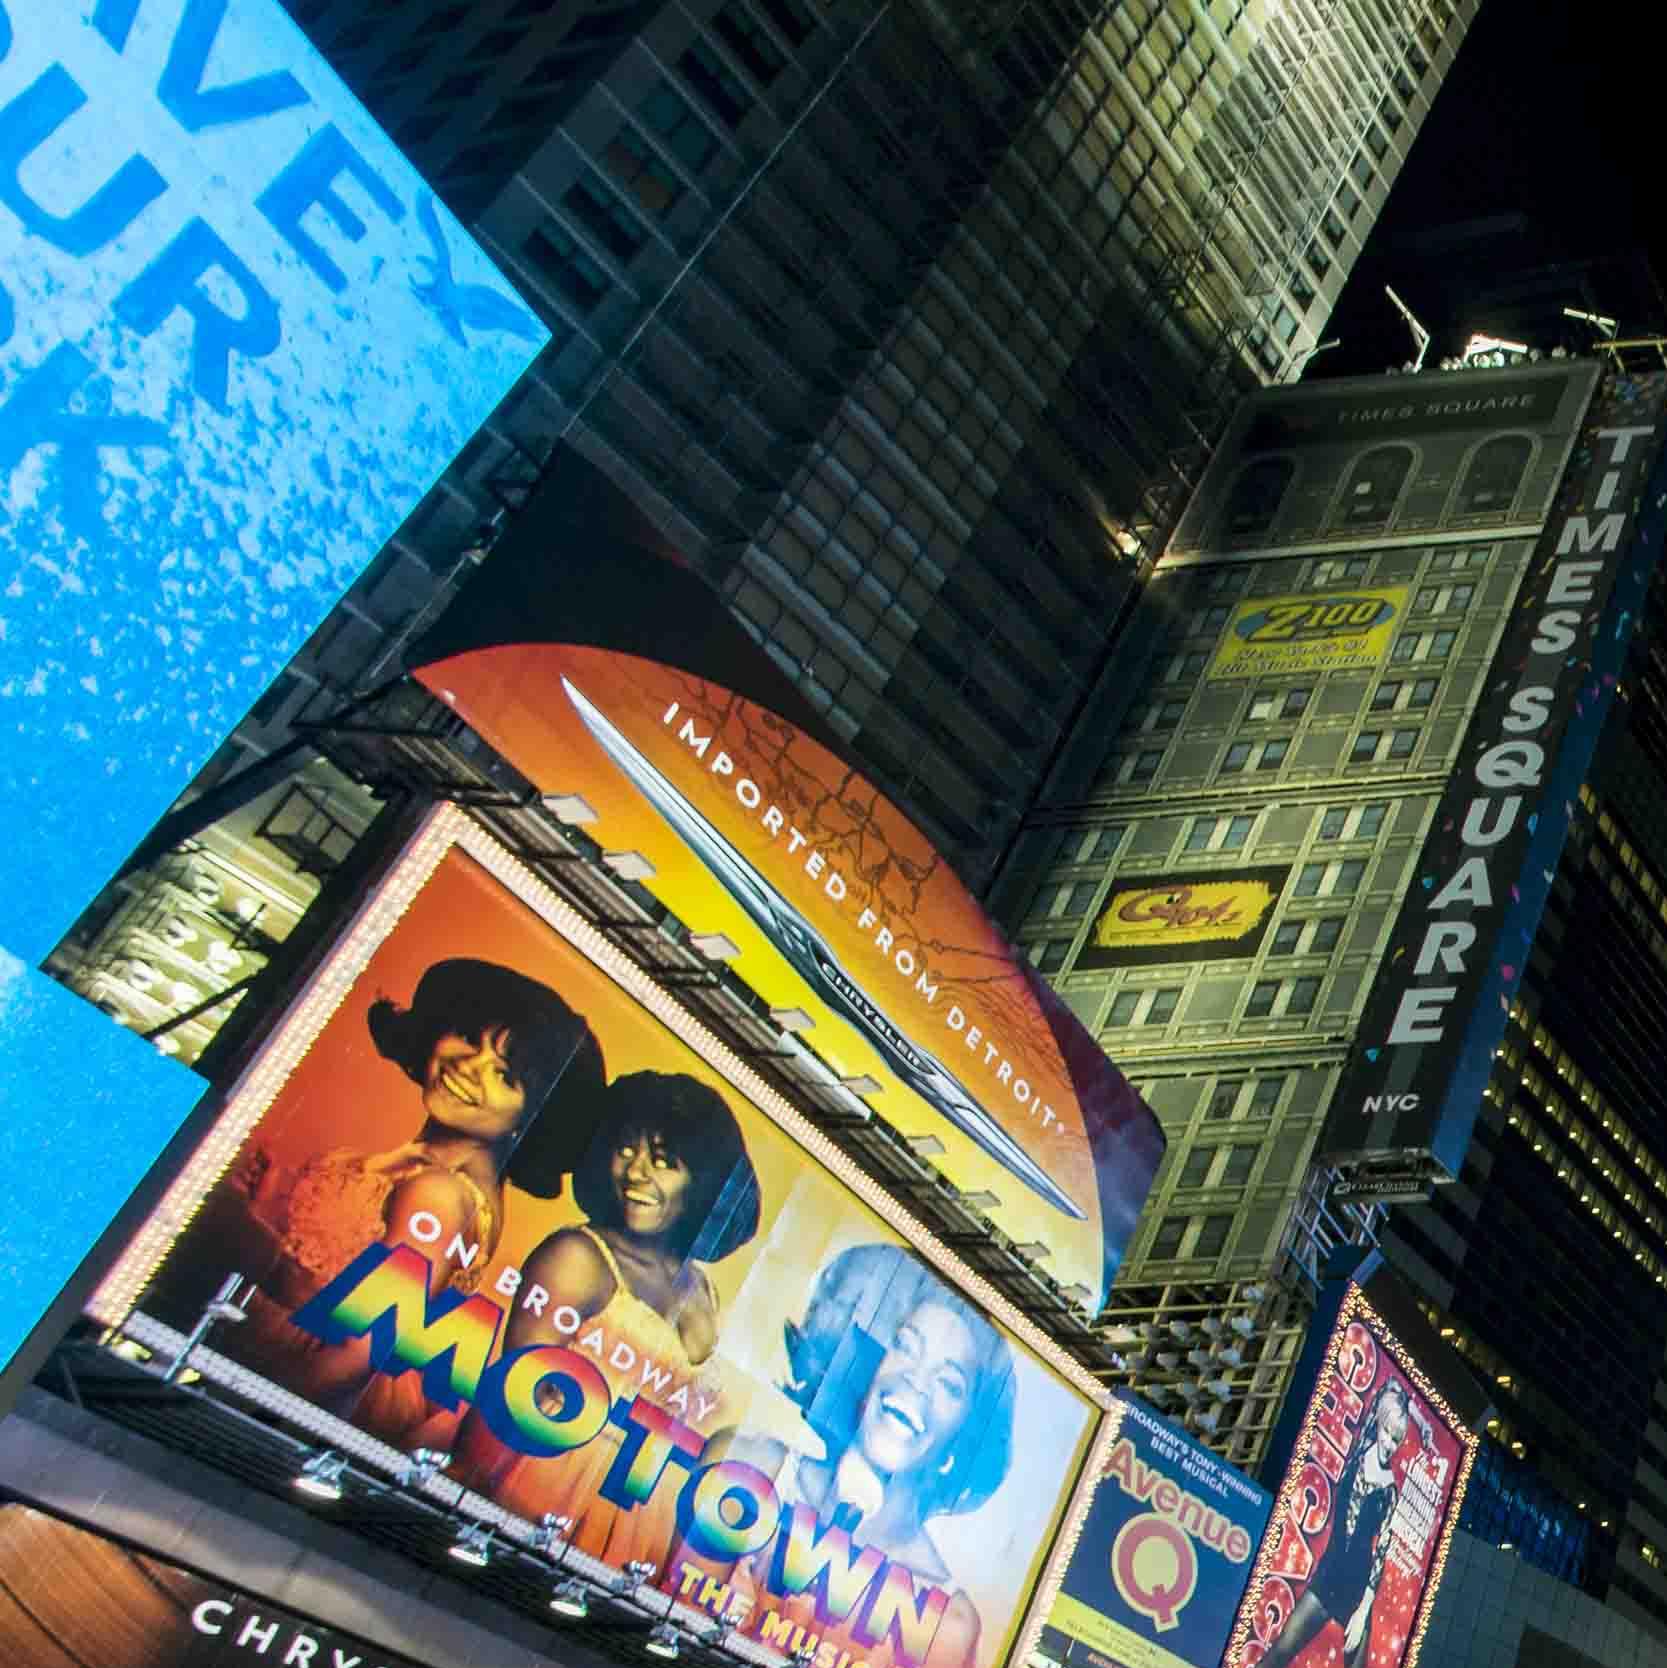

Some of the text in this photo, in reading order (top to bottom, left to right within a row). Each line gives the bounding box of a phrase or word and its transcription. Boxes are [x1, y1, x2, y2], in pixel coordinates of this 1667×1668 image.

[1248, 598, 1386, 643] Z100
[1387, 425, 1654, 1043] TIMES SQUARE
[662, 700, 940, 1002] IMPORTED FROM
[821, 961, 921, 1066] CHRYSLER
[1362, 1094, 1420, 1113] NYC
[406, 1210, 716, 1424] ON BROADWAY
[291, 1243, 952, 1668] MOTOWN
[1100, 1438, 1251, 1562] Avenue
[1150, 1436, 1229, 1498] BEST MUSICAL
[680, 1562, 752, 1616] THE
[1111, 1512, 1197, 1632] Q
